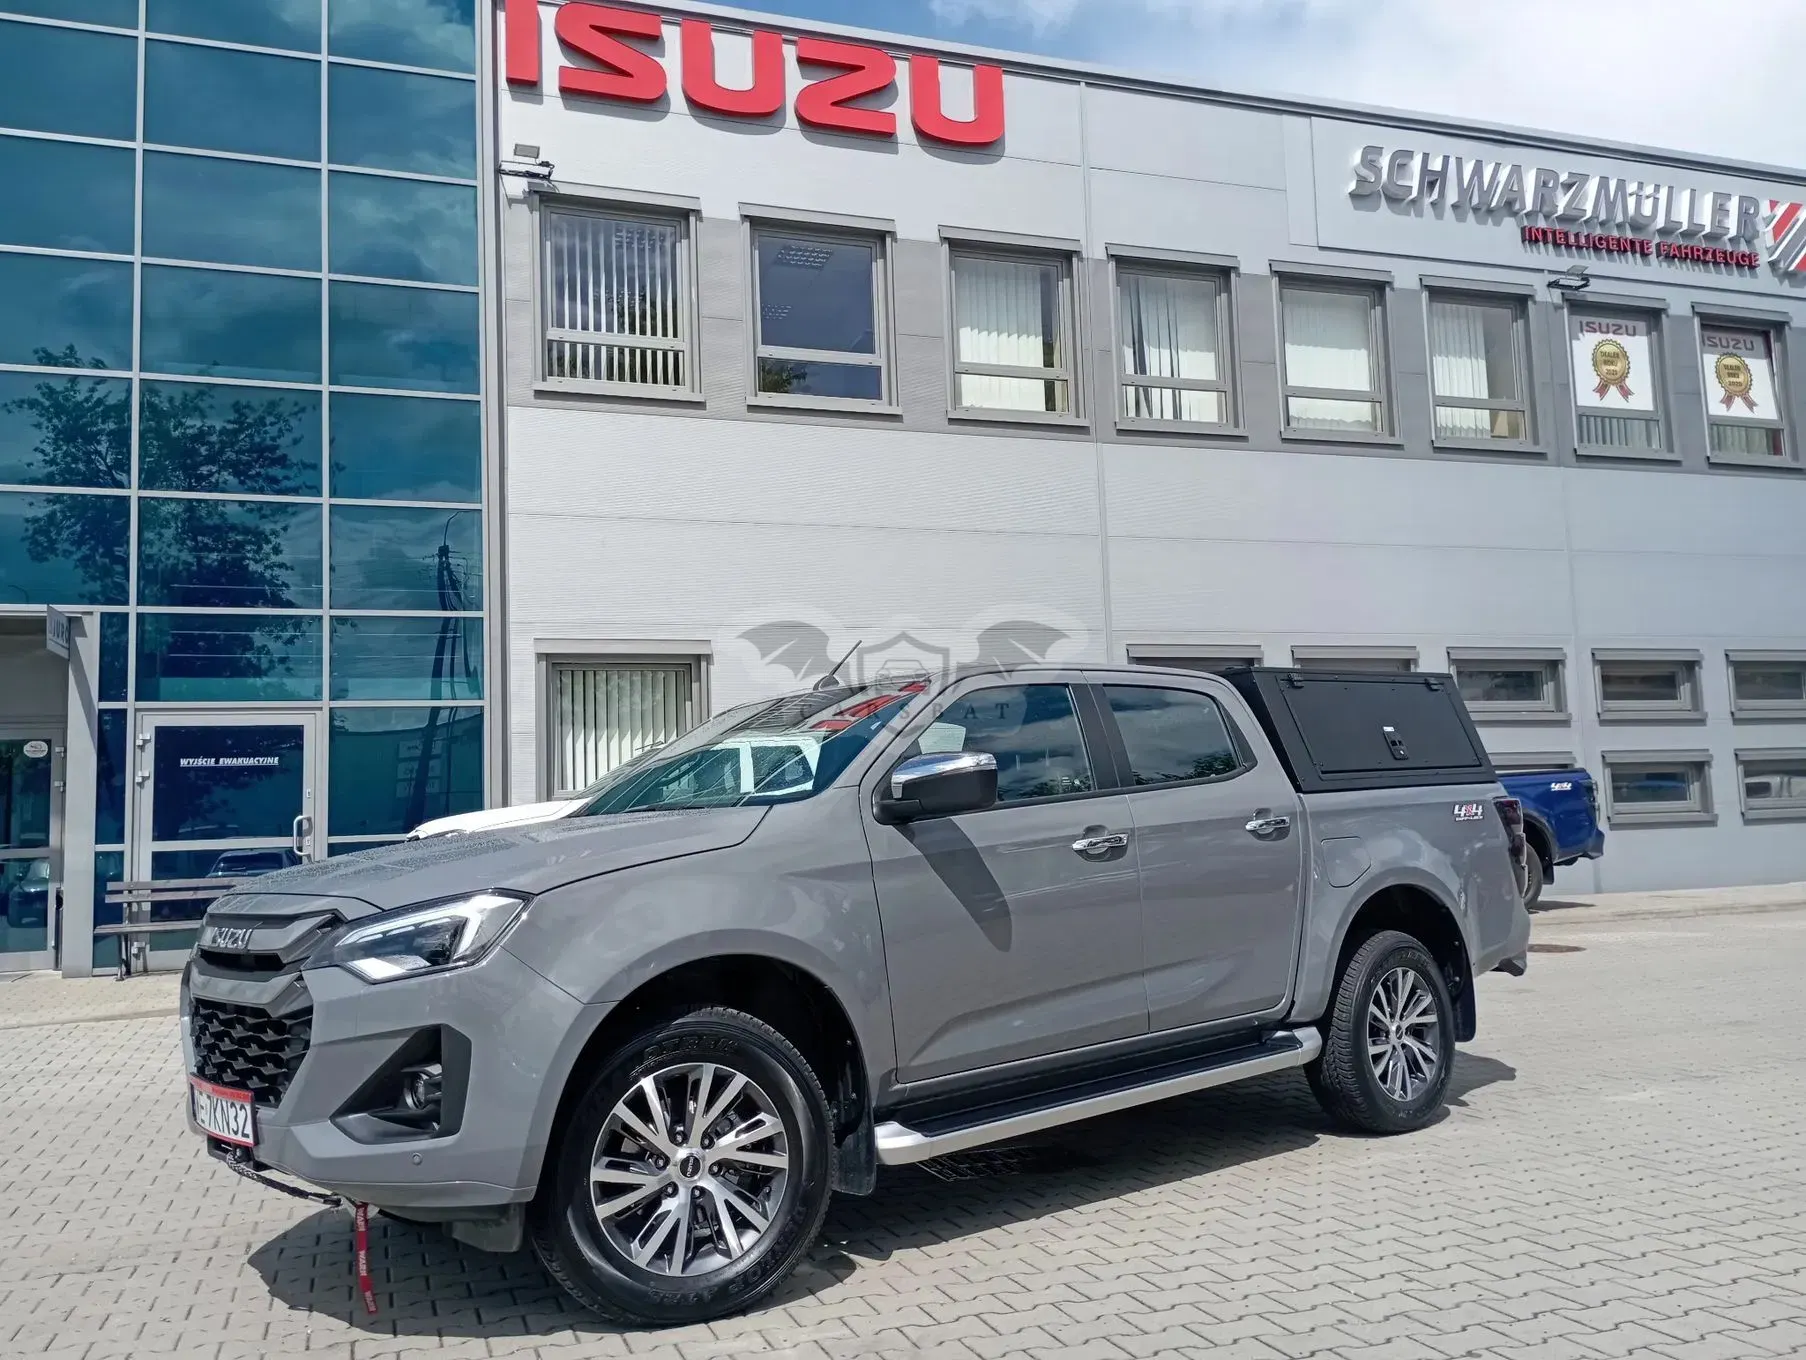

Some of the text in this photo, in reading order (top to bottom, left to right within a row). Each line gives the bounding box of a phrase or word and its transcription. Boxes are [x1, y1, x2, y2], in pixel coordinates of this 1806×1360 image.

[506, 0, 1003, 145] ISUZU
[1350, 145, 1761, 242] SCHWARZMÜLLER
[1522, 225, 1761, 268] INTELLIGENTE FAHRZEUGE
[1580, 320, 1637, 337] ISUZU
[1701, 334, 1755, 351] ISUZU
[219, 756, 279, 767] EWAKUACYJNE
